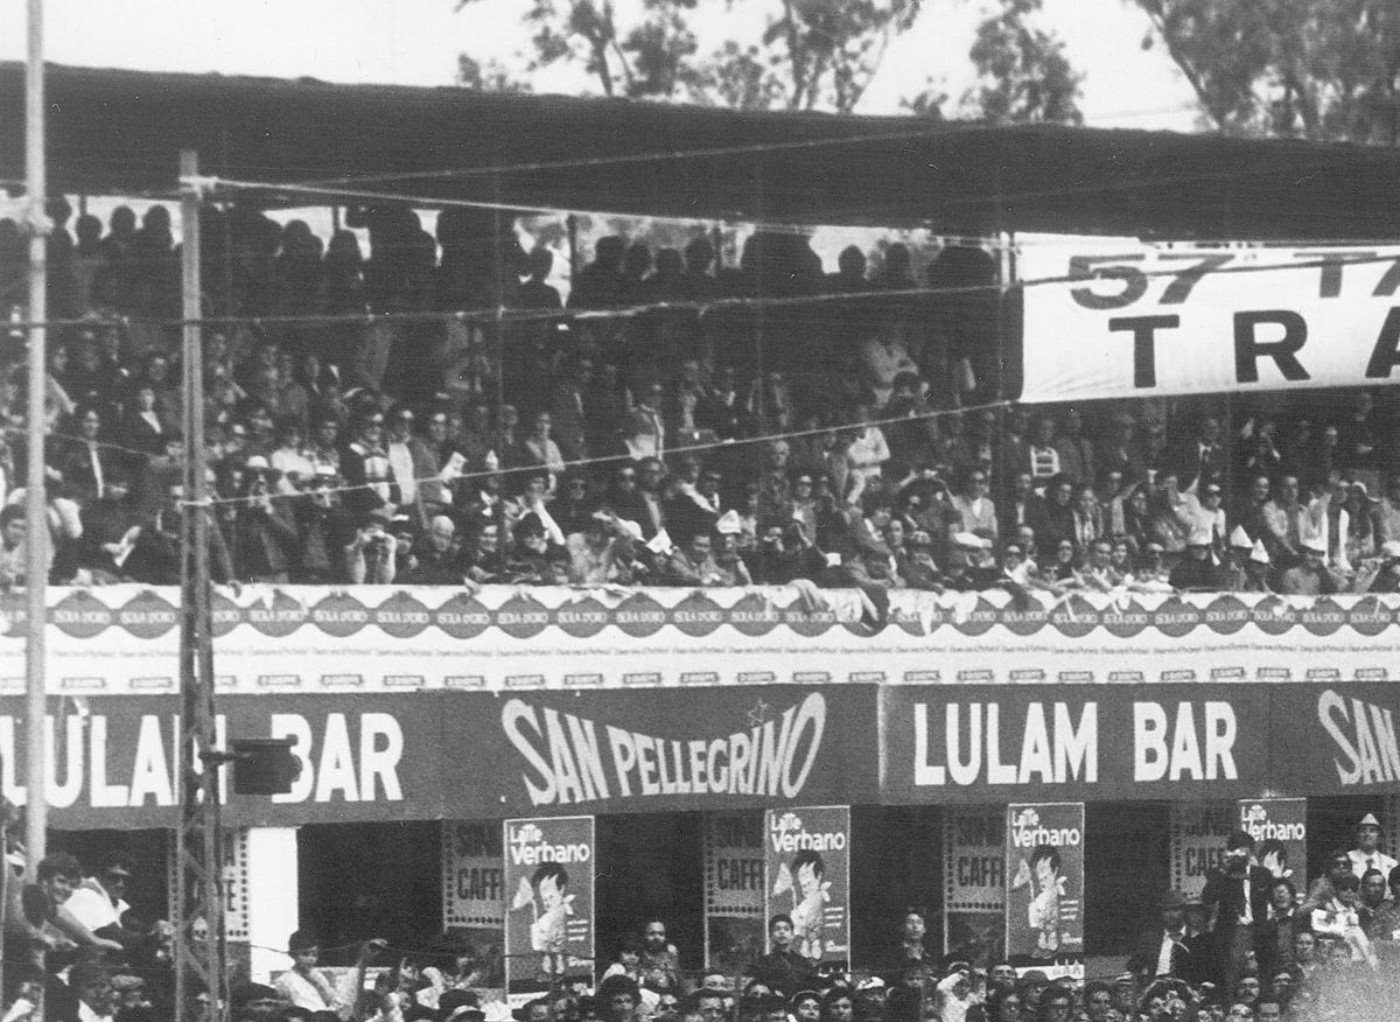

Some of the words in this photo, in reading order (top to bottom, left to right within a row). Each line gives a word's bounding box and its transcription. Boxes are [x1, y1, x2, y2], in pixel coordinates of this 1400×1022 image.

[271, 712, 404, 803] BAR
[502, 698, 610, 806] SAN
[605, 692, 827, 799] PELLEGRINO
[914, 701, 1098, 786] LULAM
[1133, 701, 1239, 782] BAR
[457, 868, 501, 900] CAFF
[718, 858, 766, 890] CAFF
[957, 856, 1001, 887] CAFF
